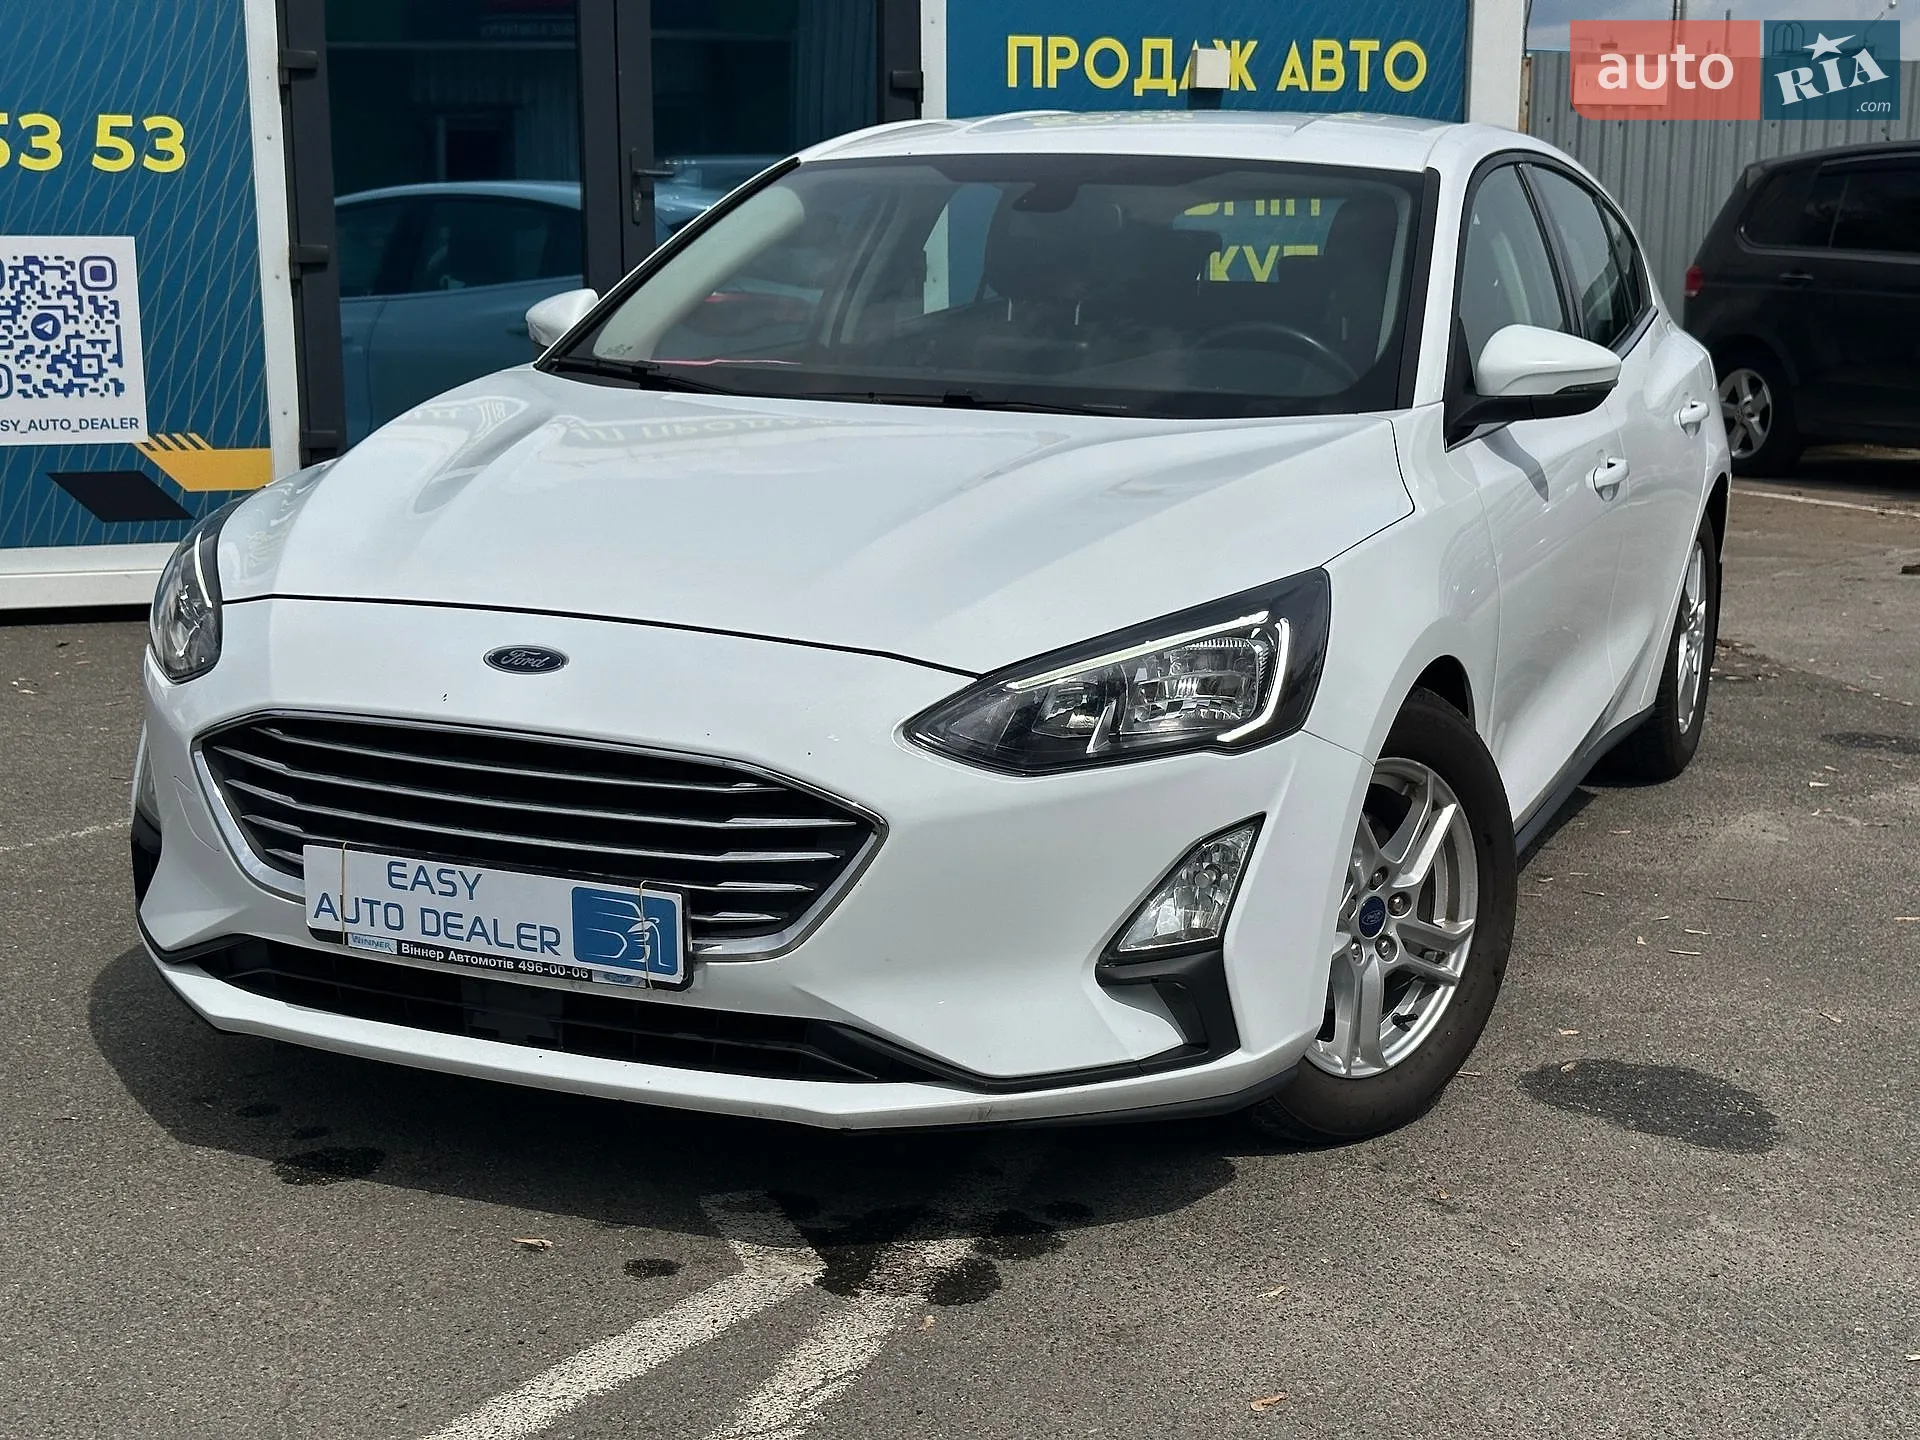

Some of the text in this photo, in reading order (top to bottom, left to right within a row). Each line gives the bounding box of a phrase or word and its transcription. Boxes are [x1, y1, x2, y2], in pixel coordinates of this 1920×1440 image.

[1276, 39, 1428, 92] АВТО
[0, 112, 186, 173] 3 53
[500, 649, 550, 668] Ford
[387, 860, 482, 901] EASY
[313, 892, 561, 956] AUTO DEALER
[401, 942, 444, 961] Віннер
[448, 950, 514, 969] Автомотів
[518, 959, 589, 979] 496-00-06
